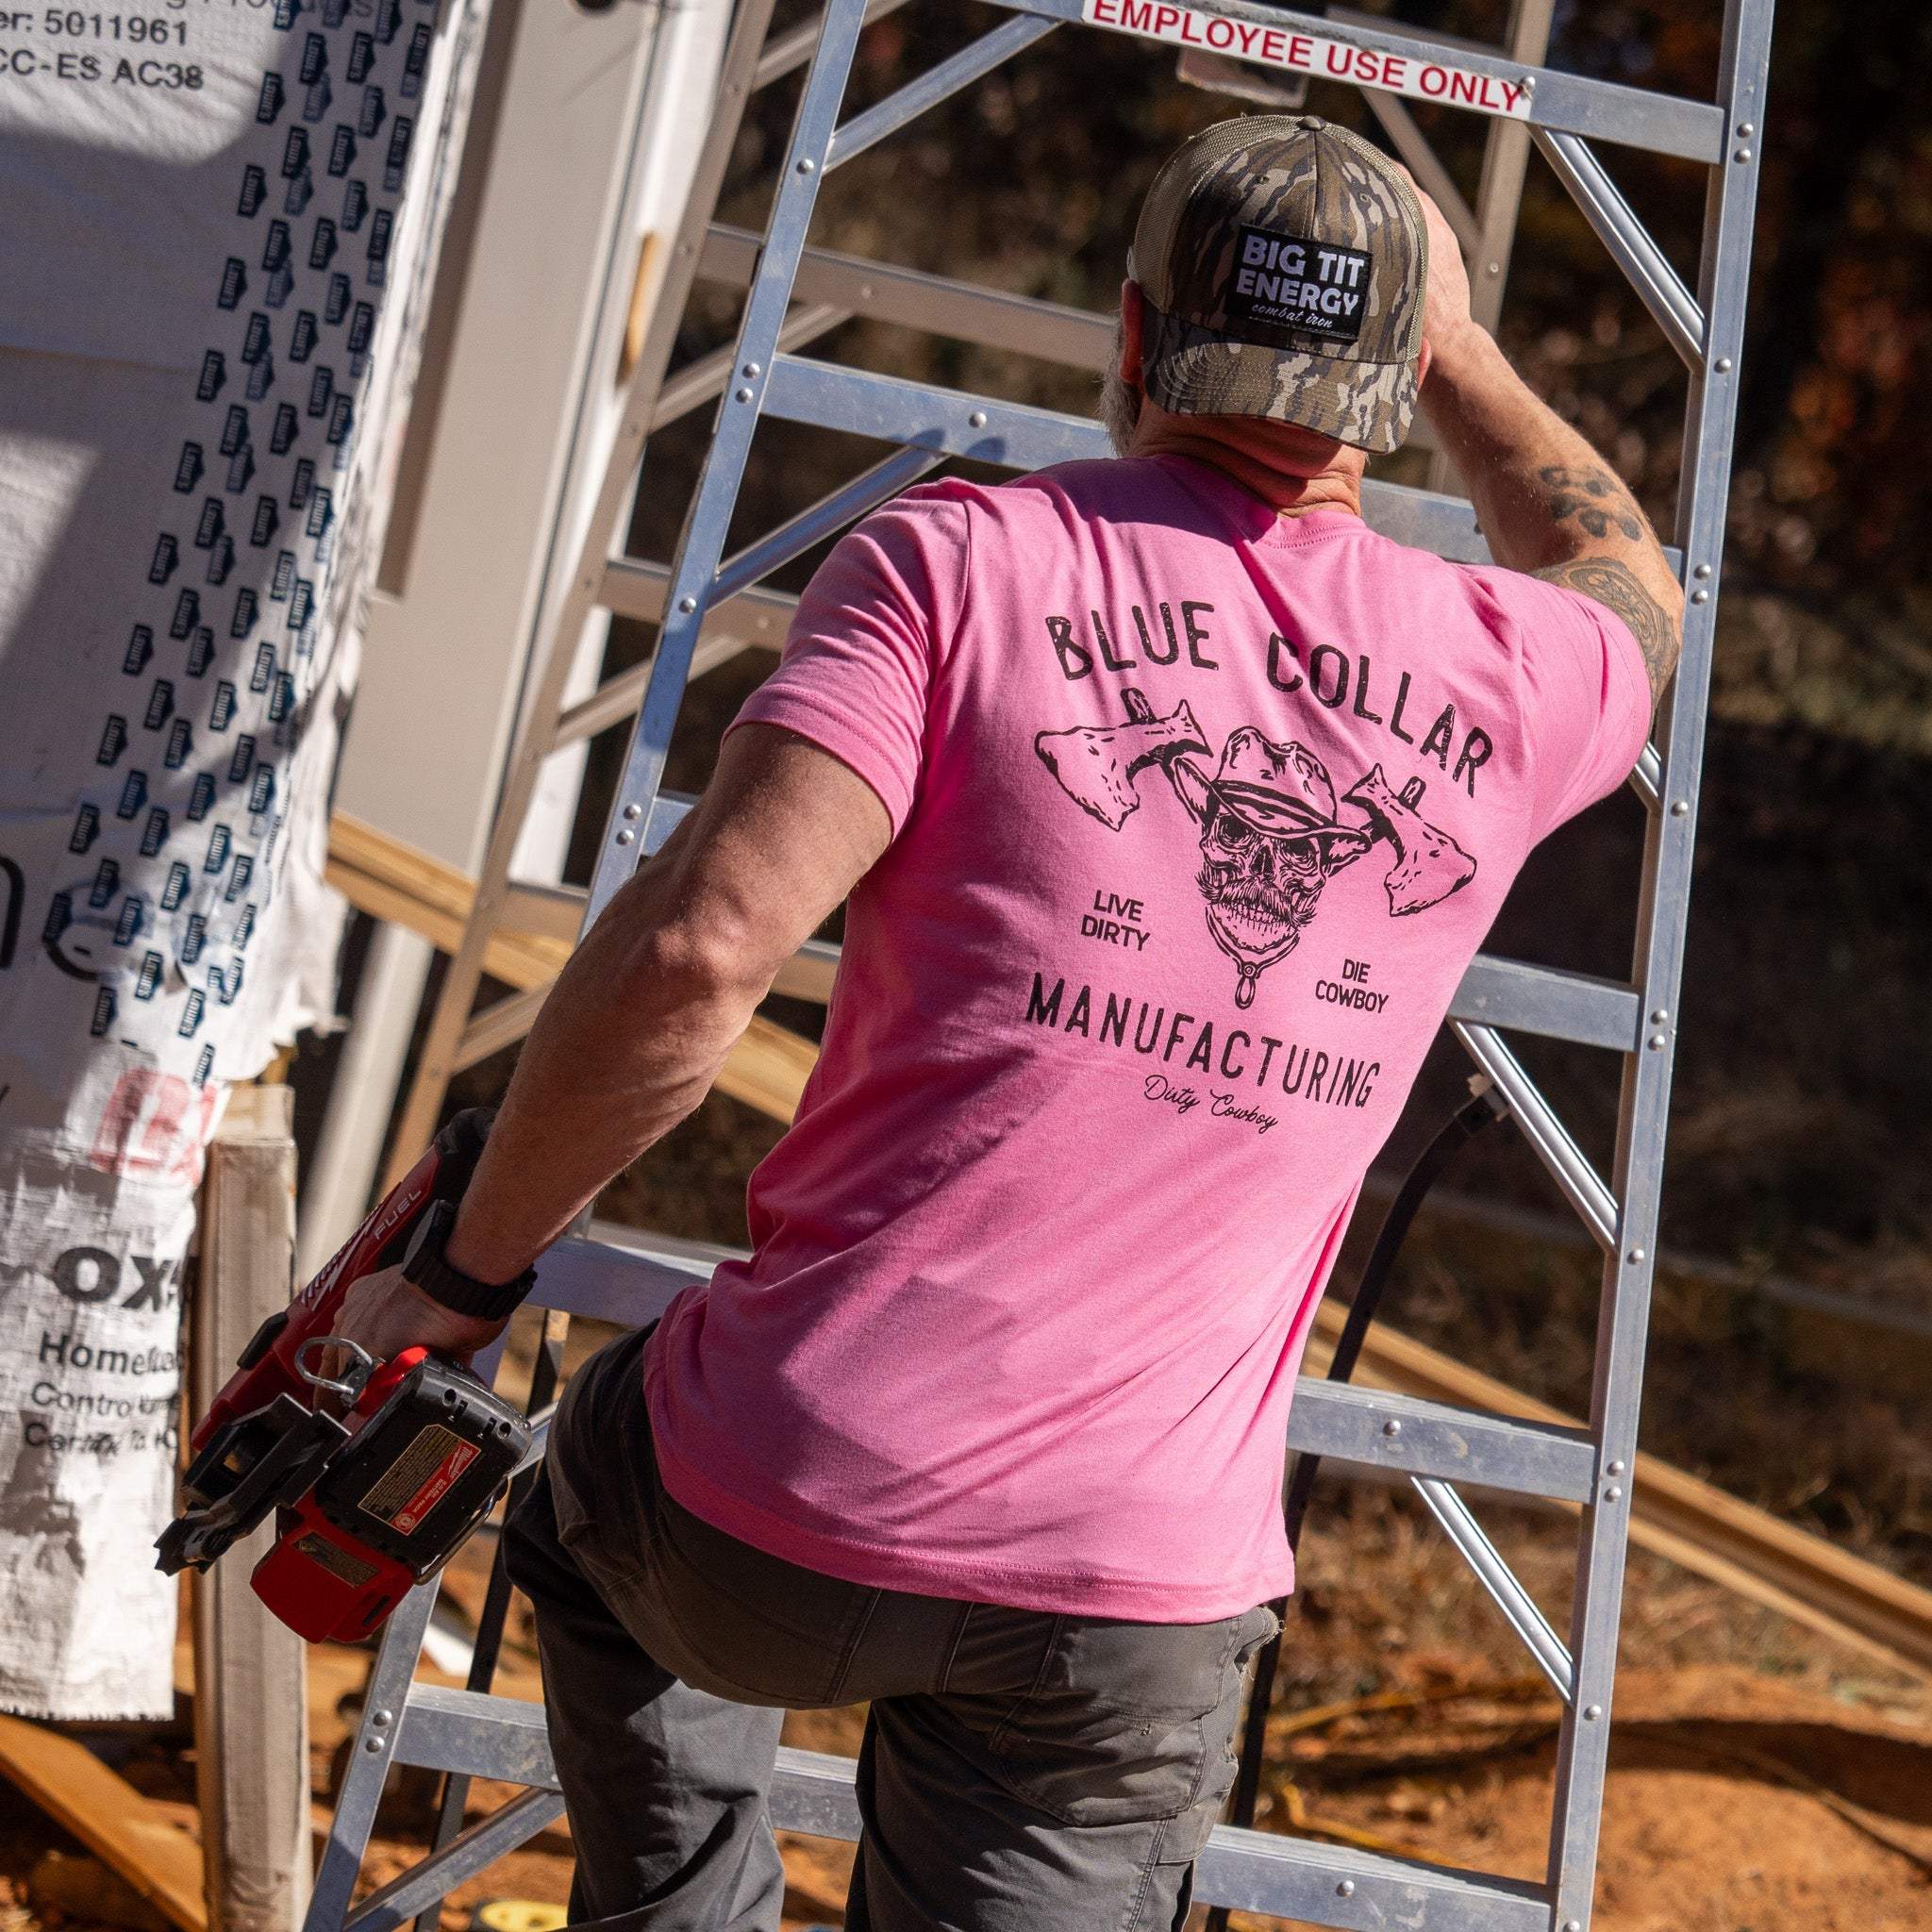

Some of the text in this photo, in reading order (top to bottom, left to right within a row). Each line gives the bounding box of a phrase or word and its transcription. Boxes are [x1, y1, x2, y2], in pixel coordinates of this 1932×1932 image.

[44, 9, 188, 46] 5011961
[111, 58, 204, 91] AC38
[1092, 0, 1522, 112] EMPLOYEE USE ONLY
[1241, 235, 1364, 288] BIG TIT
[1236, 268, 1359, 316] ENERGY
[1251, 303, 1302, 323] combat
[1305, 312, 1334, 329] iron
[1044, 600, 1493, 799] BLUE COLLAR
[1092, 890, 1145, 923] LIVE
[1080, 914, 1151, 952] DIRTY
[1341, 958, 1372, 984] DIE
[1314, 979, 1390, 1014] COWBOY
[1024, 971, 1382, 1109] MANUFACTURING
[1143, 1074, 1280, 1135] Dirty Cowboy
[374, 1189, 423, 1241] FUEL
